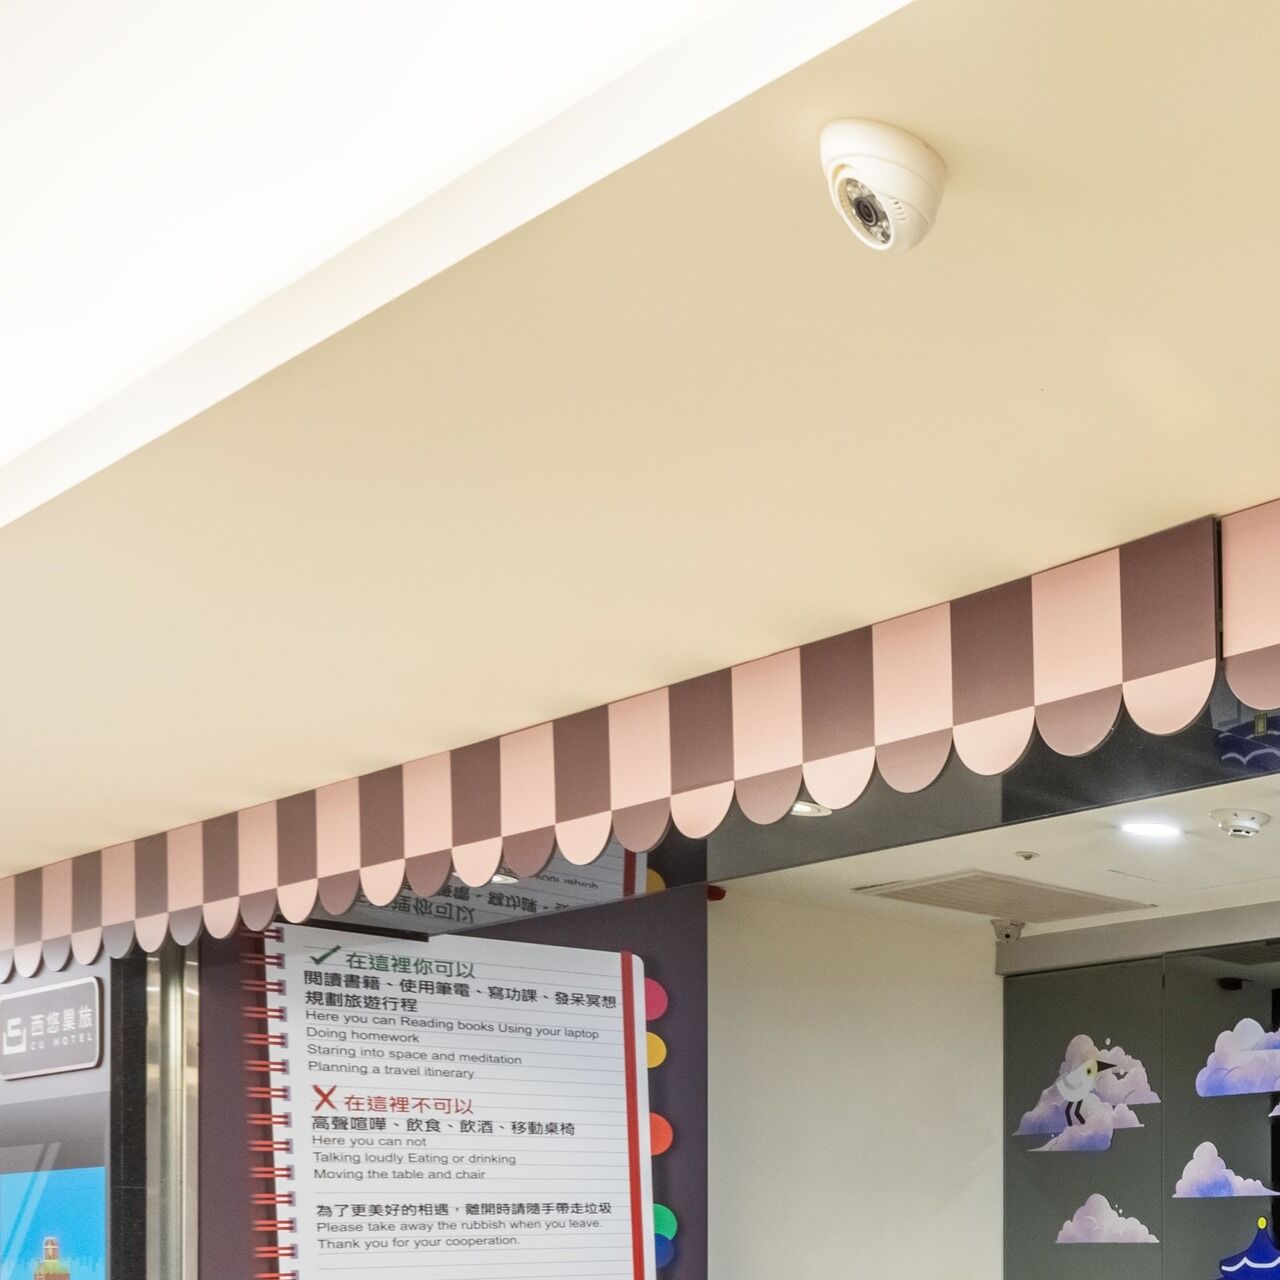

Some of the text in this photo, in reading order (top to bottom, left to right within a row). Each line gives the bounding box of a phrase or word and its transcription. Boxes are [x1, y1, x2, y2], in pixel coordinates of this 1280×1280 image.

[346, 952, 476, 979] 在這裡你可以
[305, 990, 418, 1013] 規劃旅遊行程
[305, 1009, 600, 1040] Here you can Reading books Using your laptop
[306, 1026, 420, 1043] Doing homework
[307, 1043, 522, 1065] Staring into space and meditation
[308, 1061, 475, 1080] Planning a travel itinerary
[344, 1094, 474, 1115] 在這裡不可以
[312, 1134, 427, 1148] Here you can not
[313, 1151, 517, 1166] Talking loudly Eating or drinking
[314, 1169, 486, 1180] Moving the table and chair
[316, 1219, 603, 1233] Please take away the rubbish when you leave.
[318, 1236, 520, 1250] Thank you for your cooperation.
